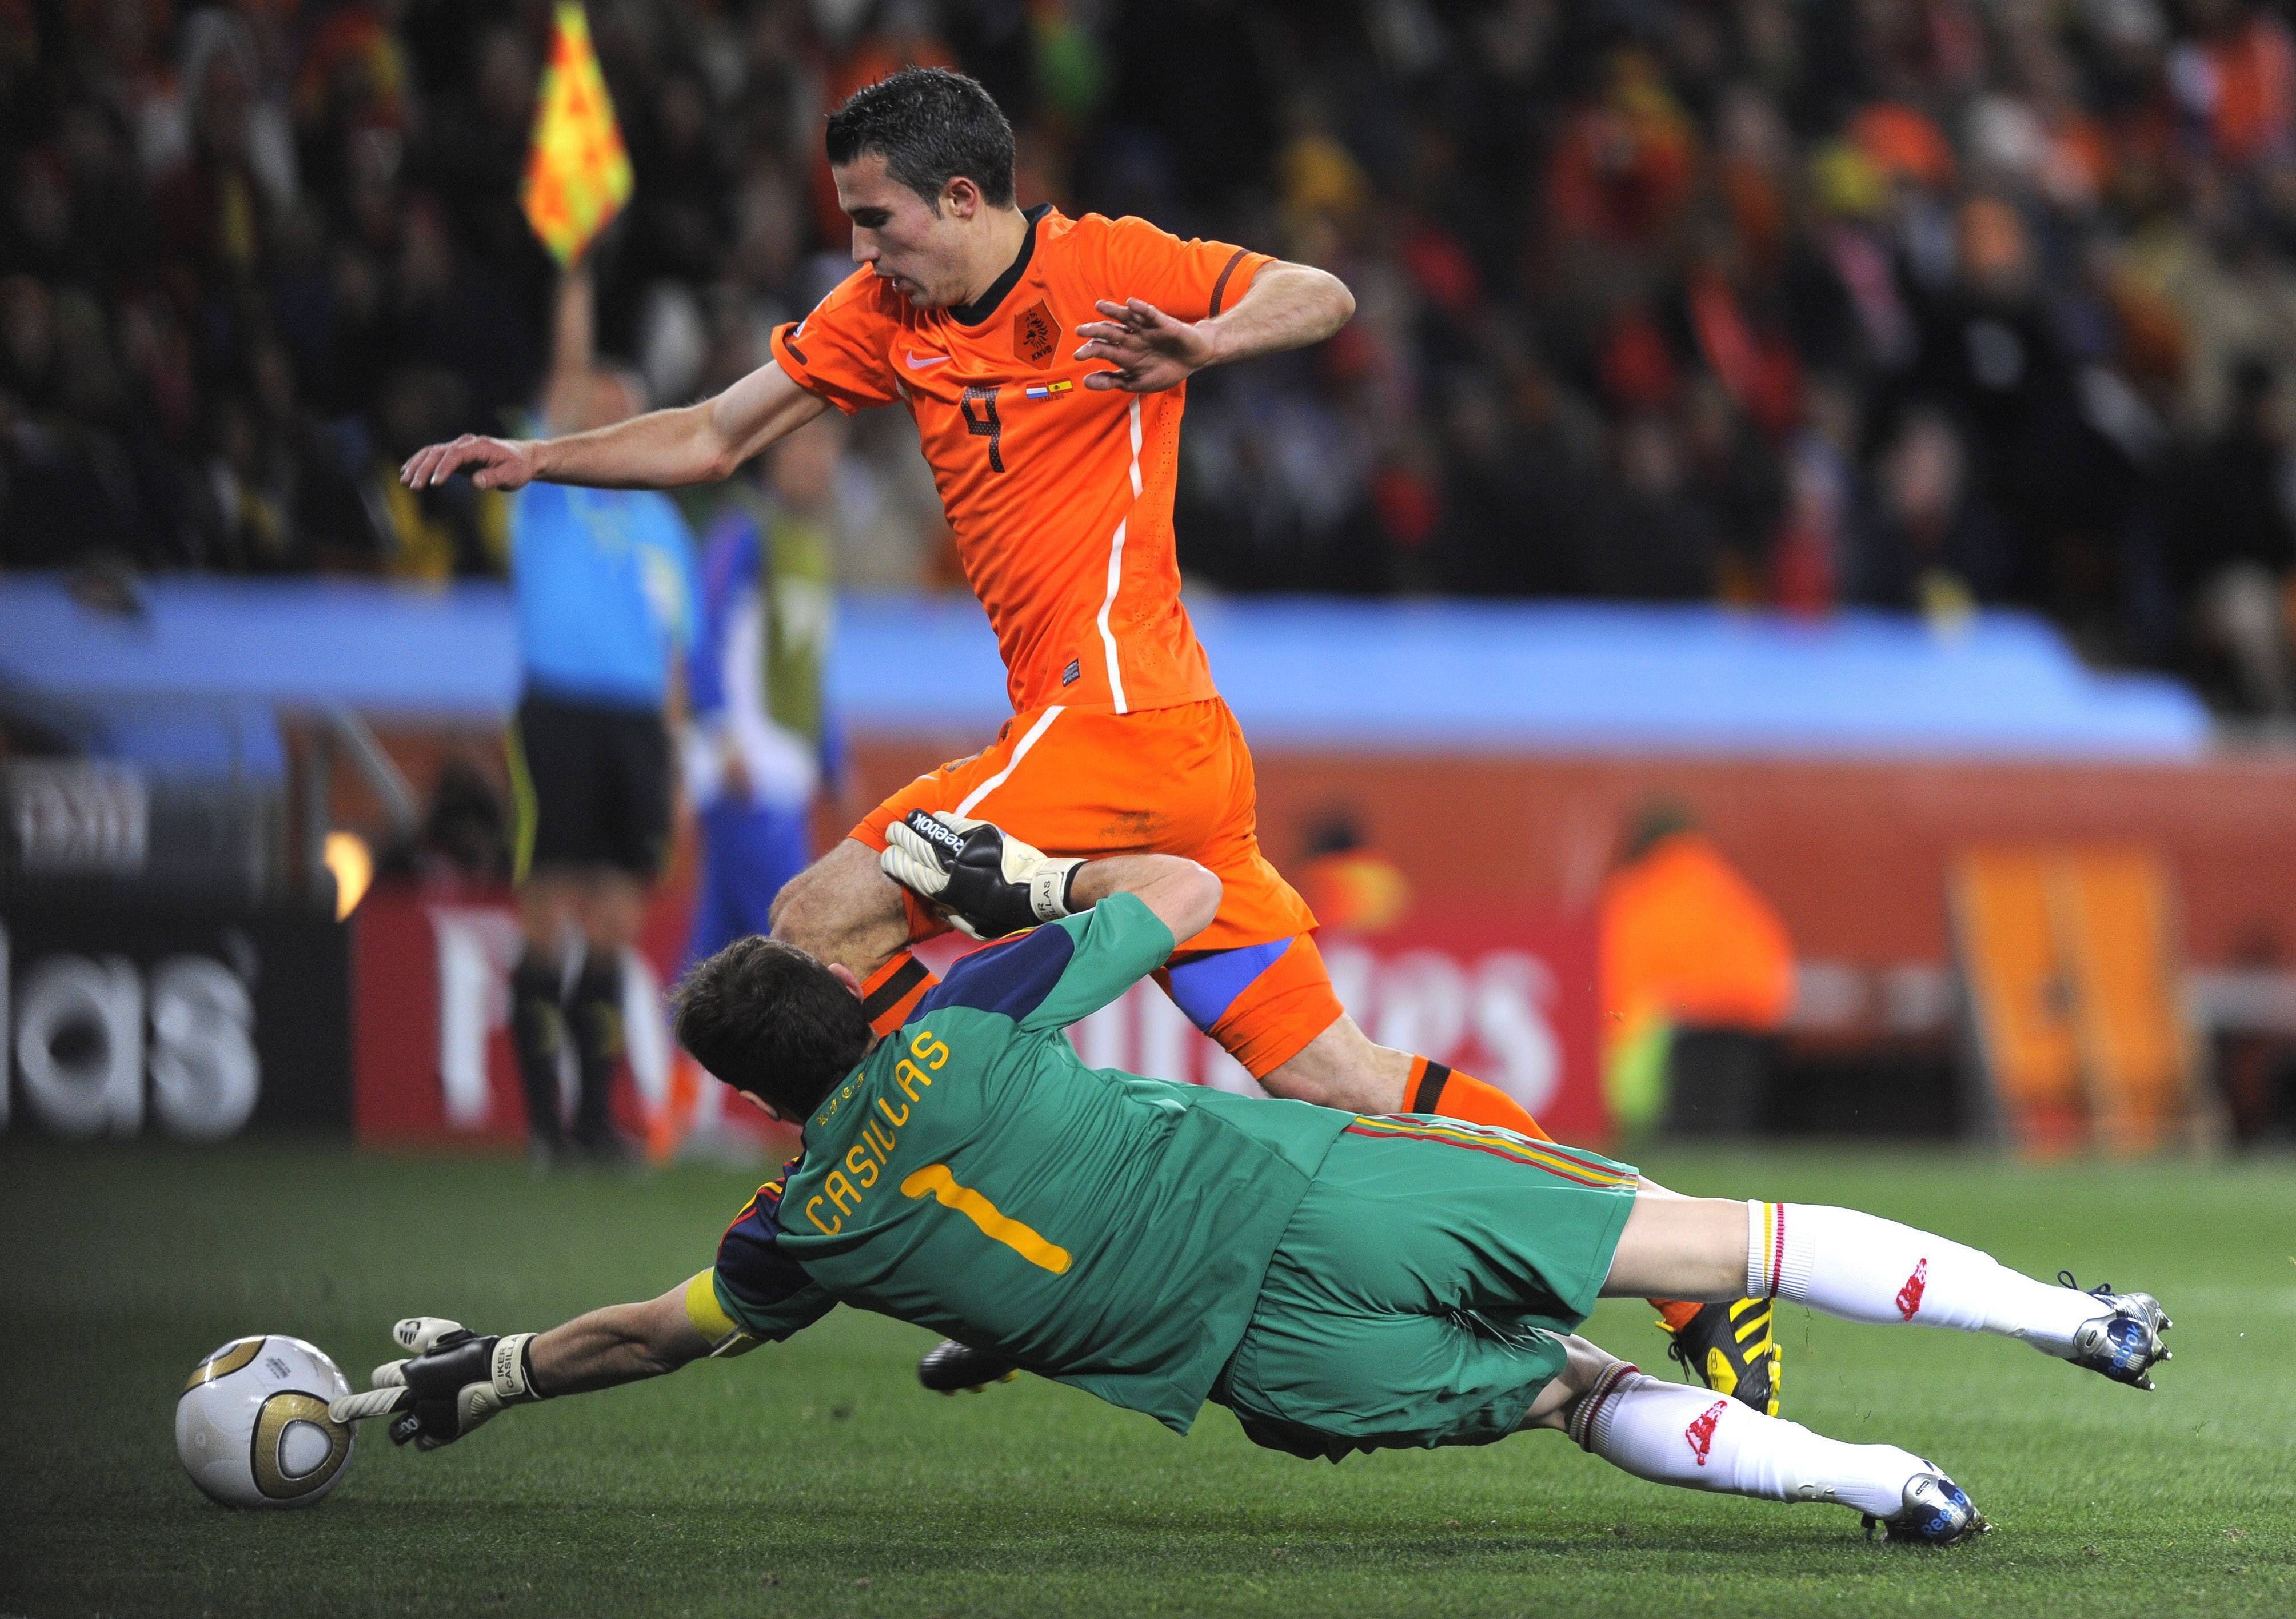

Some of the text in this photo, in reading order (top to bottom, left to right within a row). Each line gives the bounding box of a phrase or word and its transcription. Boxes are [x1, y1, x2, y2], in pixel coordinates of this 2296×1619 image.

[1032, 345, 1052, 361] KNVB
[961, 387, 1005, 473] 9
[912, 812, 964, 857] Reebok
[805, 1031, 949, 1236] CASILLAS
[900, 1163, 1073, 1275] 1
[497, 1347, 506, 1378] IKER
[505, 1335, 519, 1389] CASILLA
